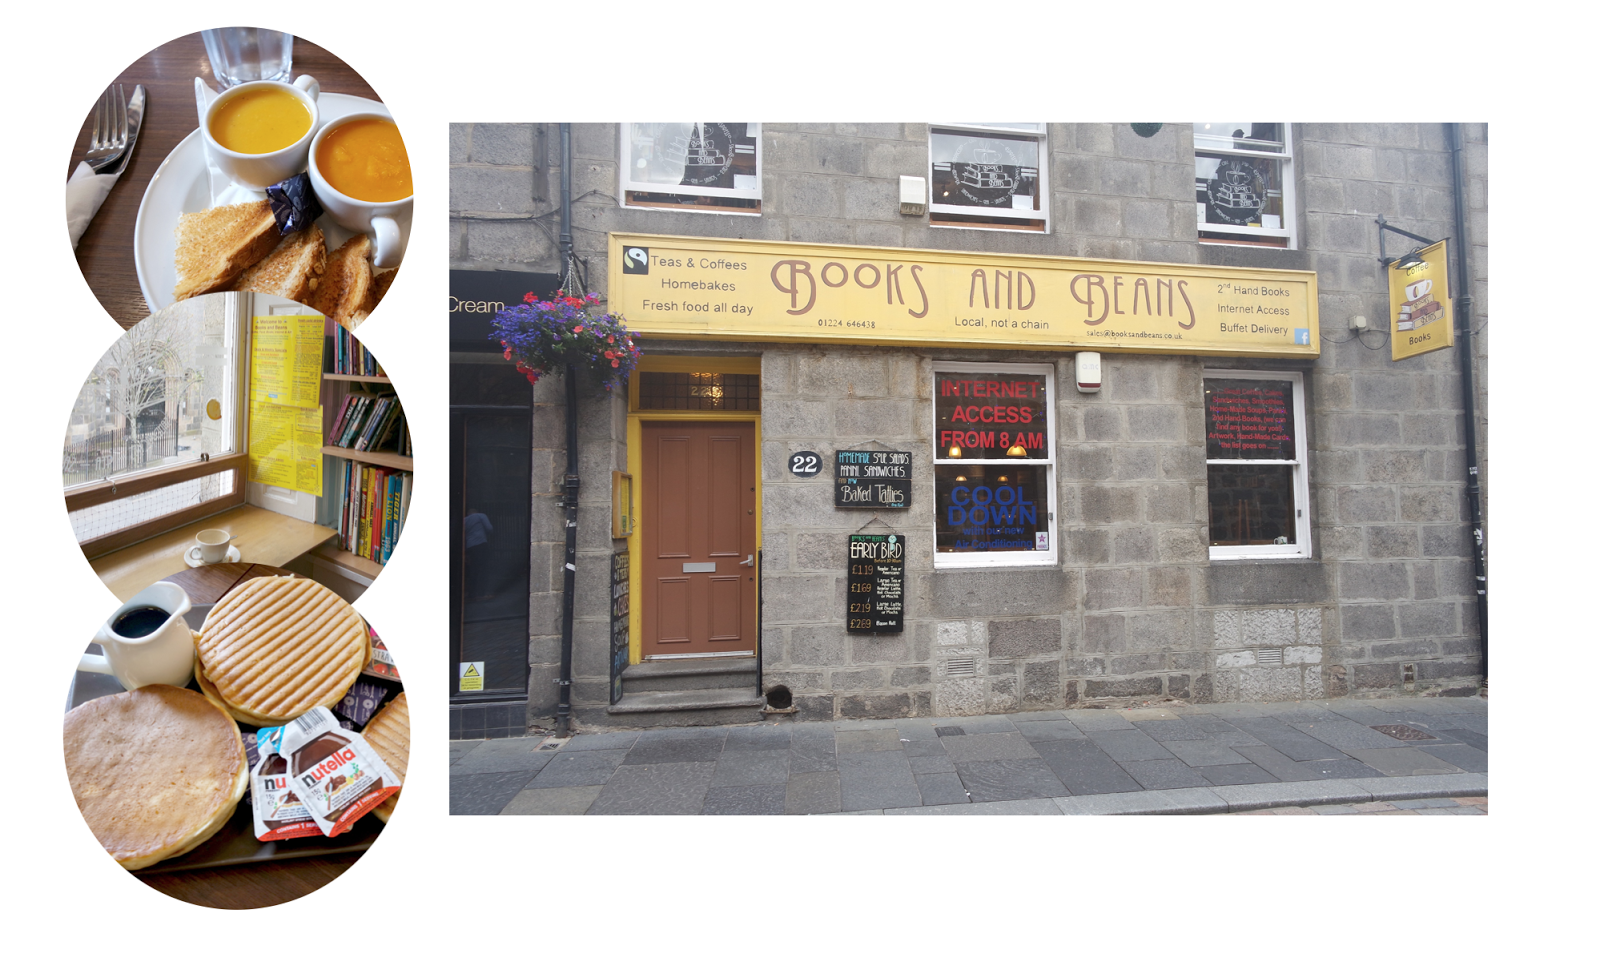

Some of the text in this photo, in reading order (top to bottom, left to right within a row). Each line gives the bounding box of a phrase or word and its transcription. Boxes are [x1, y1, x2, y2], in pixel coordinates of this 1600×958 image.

[651, 255, 747, 271] Teas & Coffees
[1406, 261, 1429, 277] Coffee
[661, 278, 736, 291] Homebakes
[1217, 282, 1290, 297] 2nd Hand Books
[770, 259, 1196, 331] BOOKS AND BEANS
[449, 295, 505, 314] Cream
[642, 299, 754, 316] Fresh food all day
[1218, 303, 1290, 316] Internet Access
[818, 318, 876, 329] 01224 646438
[955, 317, 1049, 330] Local, not a chain
[1220, 322, 1288, 336] Buffet Delivery
[1086, 329, 1183, 341] sales@booksandbeans.co.uk
[1409, 333, 1431, 345] Books
[941, 380, 1040, 398] INTERNET
[951, 405, 1033, 423] ACCESS
[941, 431, 1043, 449] FROM 8 AM
[792, 455, 818, 473] 22
[838, 452, 870, 464] HOMEMADE
[874, 484, 904, 504] Tatties
[951, 486, 1033, 506] COOL
[393, 492, 401, 520] TIGER
[948, 505, 1037, 526] DOWN
[962, 526, 1025, 536] with our new
[850, 542, 902, 559] EARLY BIRD
[954, 539, 970, 550] Air
[971, 539, 1033, 551] Conditioning
[301, 748, 356, 788] nutella
[264, 777, 289, 790] nu
[311, 788, 321, 797] 15g
[340, 804, 358, 822] CONTAINS
[361, 792, 380, 803] SERVING
[276, 824, 300, 834] CONTAINS
